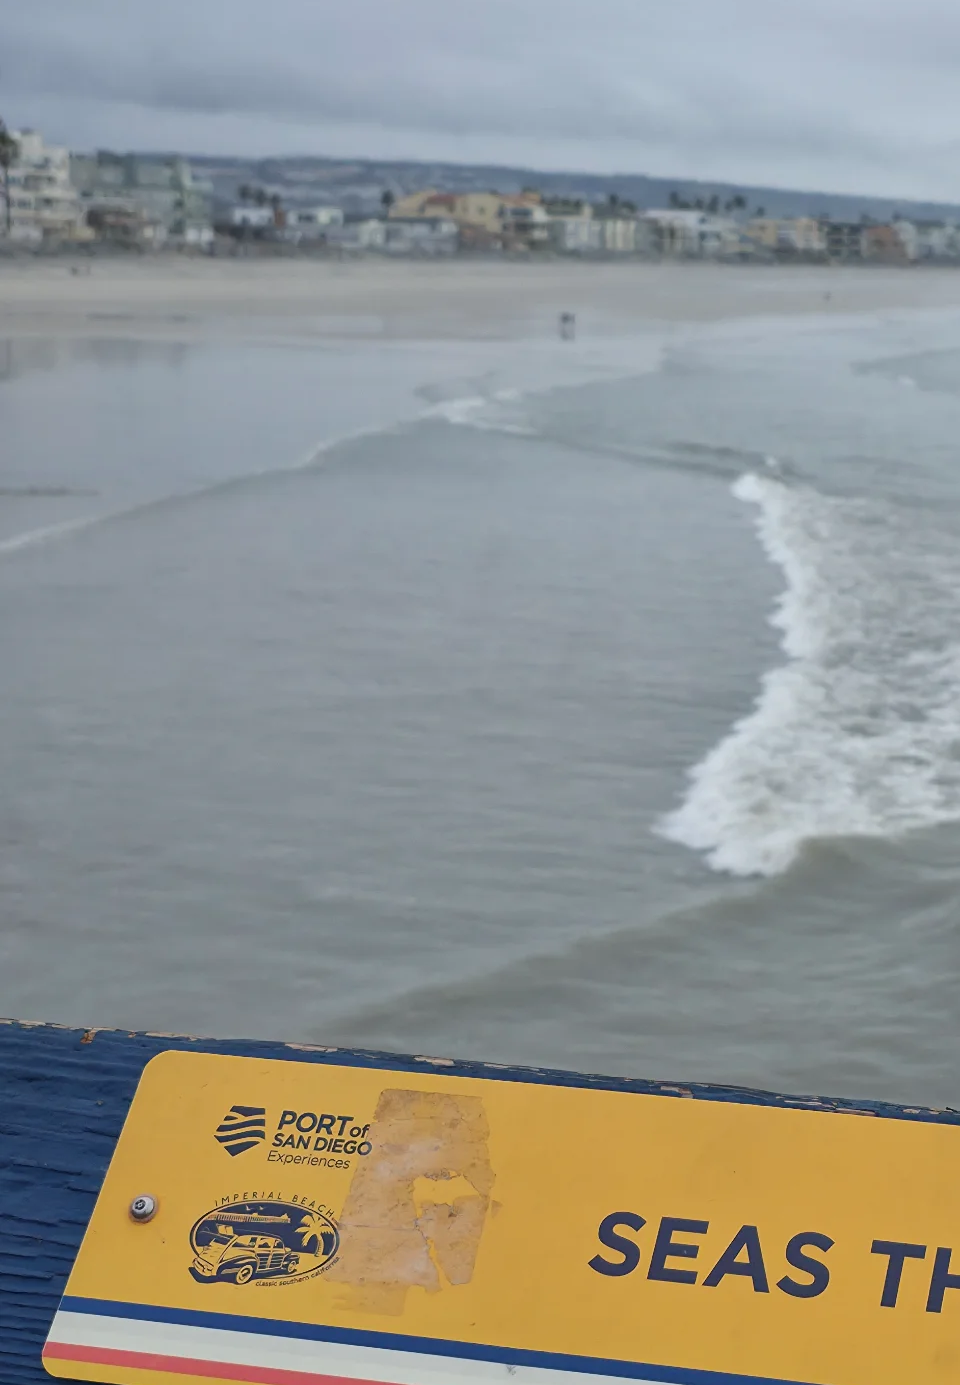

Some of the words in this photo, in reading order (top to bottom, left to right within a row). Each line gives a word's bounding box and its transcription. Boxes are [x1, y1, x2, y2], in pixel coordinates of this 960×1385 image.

[277, 1110, 354, 1137] PORT
[349, 1124, 371, 1139] of
[272, 1133, 311, 1150] SAN
[313, 1137, 373, 1156] DIEGO
[267, 1150, 351, 1170] Experiences
[214, 1191, 283, 1207] IMPERIAL
[291, 1194, 335, 1217] BEACH
[587, 1211, 836, 1299] SEAS
